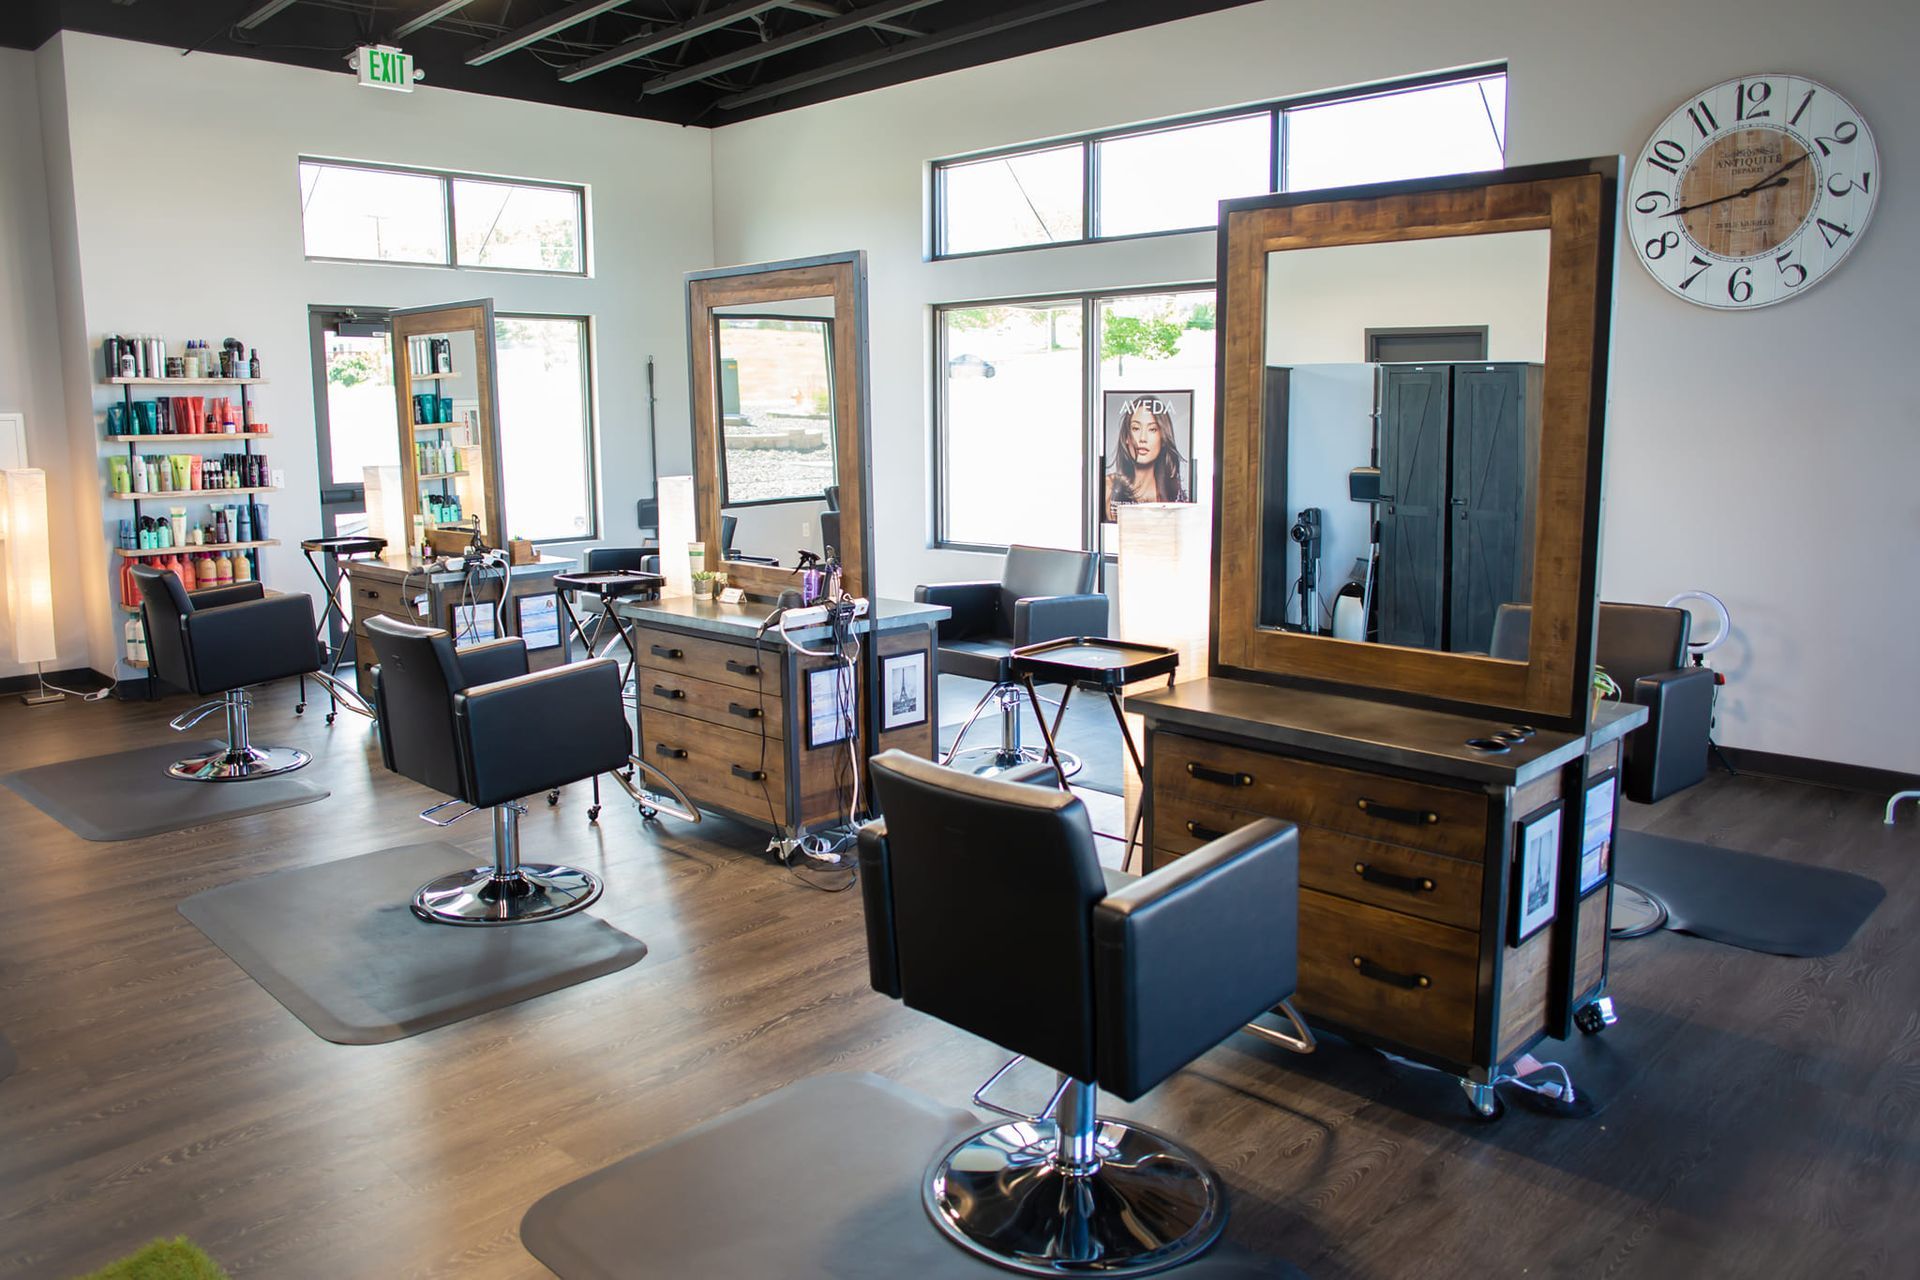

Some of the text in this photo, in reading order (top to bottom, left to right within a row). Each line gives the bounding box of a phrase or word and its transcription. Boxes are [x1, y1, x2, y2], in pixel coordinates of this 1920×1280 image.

[369, 50, 406, 85] EXIT
[1686, 100, 1719, 138] 11
[1735, 82, 1771, 121] 12
[1788, 89, 1816, 126] 1
[1814, 121, 1858, 157] 2
[1646, 140, 1686, 175] 10
[1827, 172, 1870, 197] 3
[1635, 190, 1671, 215] 9
[1645, 231, 1680, 260] 8
[1816, 217, 1854, 248] 4
[1679, 255, 1713, 290] 7
[1728, 266, 1753, 302] 6
[1776, 250, 1807, 288] 5
[1119, 399, 1176, 415] AVEDA
